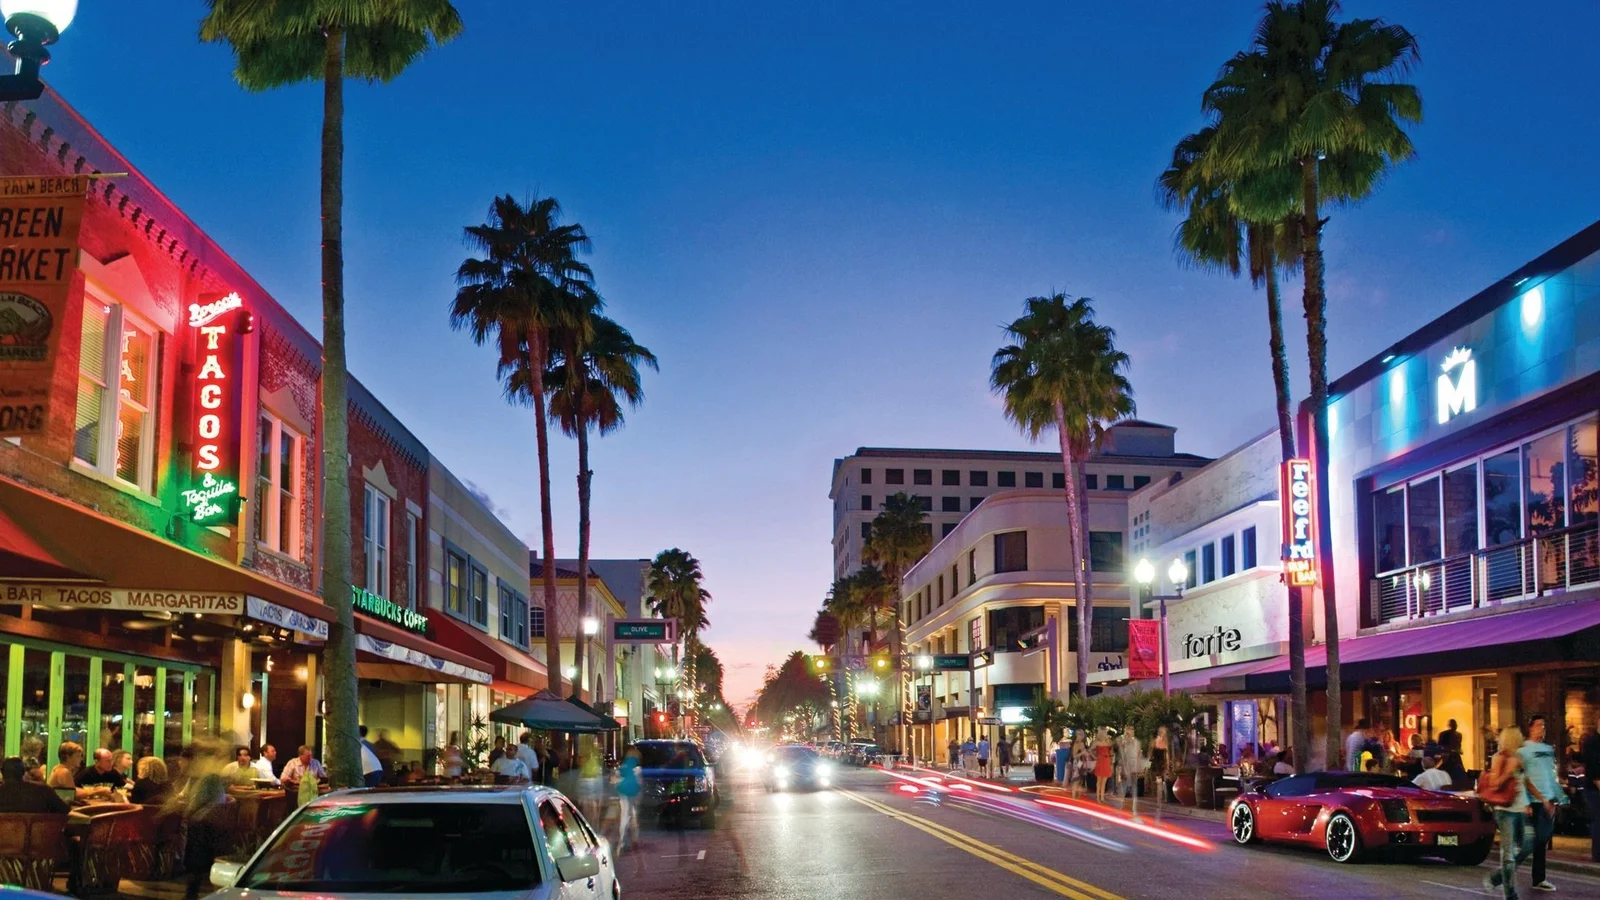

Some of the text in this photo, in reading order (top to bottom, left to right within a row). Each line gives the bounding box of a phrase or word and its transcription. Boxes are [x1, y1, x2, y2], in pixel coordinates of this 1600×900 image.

[4, 178, 79, 195] PALM BEACH
[0, 206, 64, 238] REEN
[197, 325, 227, 470] TACOS
[1438, 360, 1477, 424] M
[203, 472, 217, 488] &
[181, 480, 236, 507] Tequila
[193, 503, 224, 520] Bar
[7, 587, 238, 610] BAR TACOS MARGARITAS
[260, 603, 283, 623] TACOS
[403, 608, 429, 633] COFFE
[1181, 625, 1242, 659] forte
